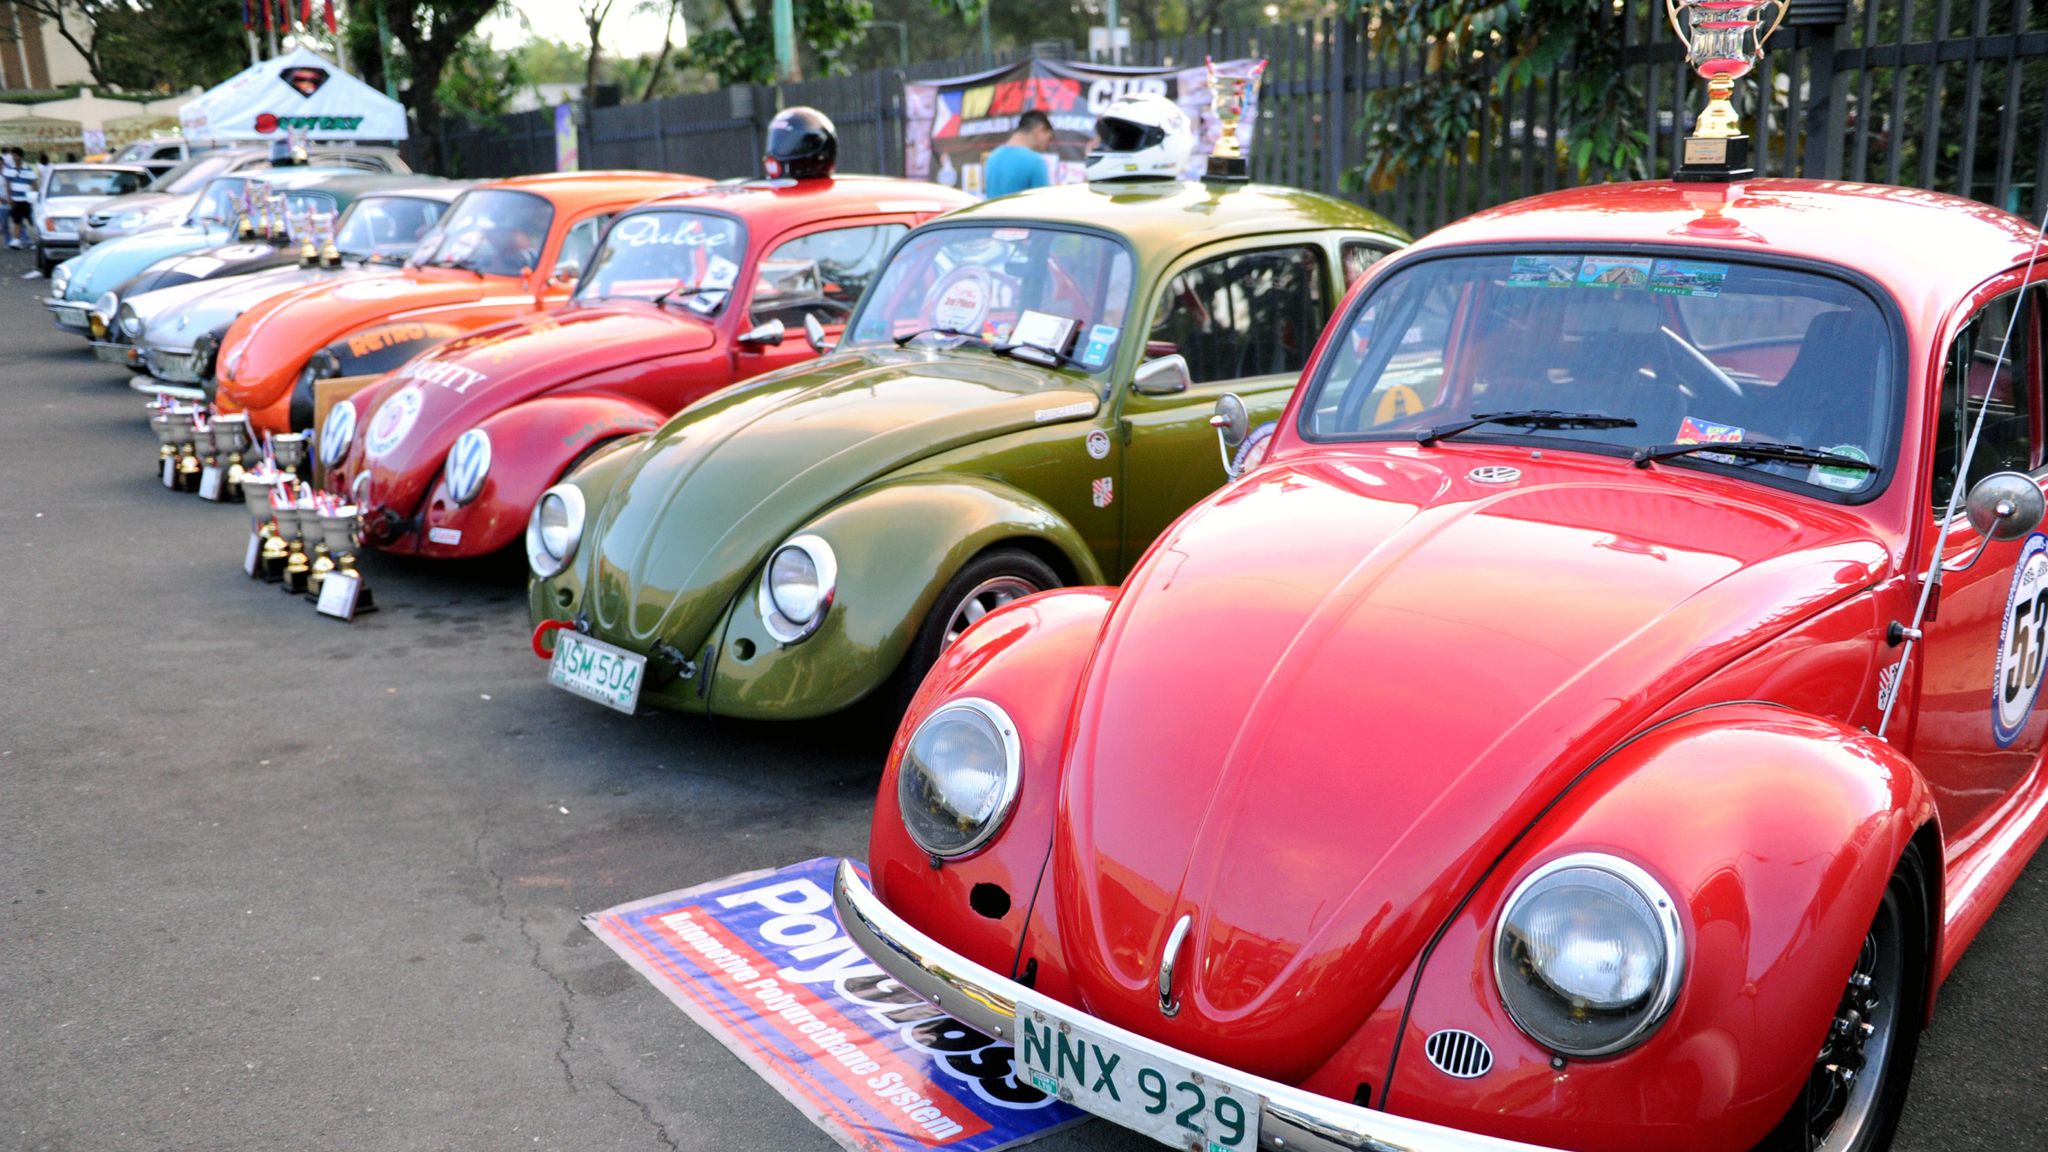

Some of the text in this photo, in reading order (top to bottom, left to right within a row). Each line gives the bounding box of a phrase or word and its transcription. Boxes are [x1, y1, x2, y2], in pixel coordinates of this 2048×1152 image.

[617, 216, 728, 247] Dulce
[555, 639, 638, 696] NSM 504
[2005, 587, 2048, 703] 53
[657, 911, 965, 1140] Automotive Polyurethane System
[1023, 1016, 1246, 1146] NNX 929
